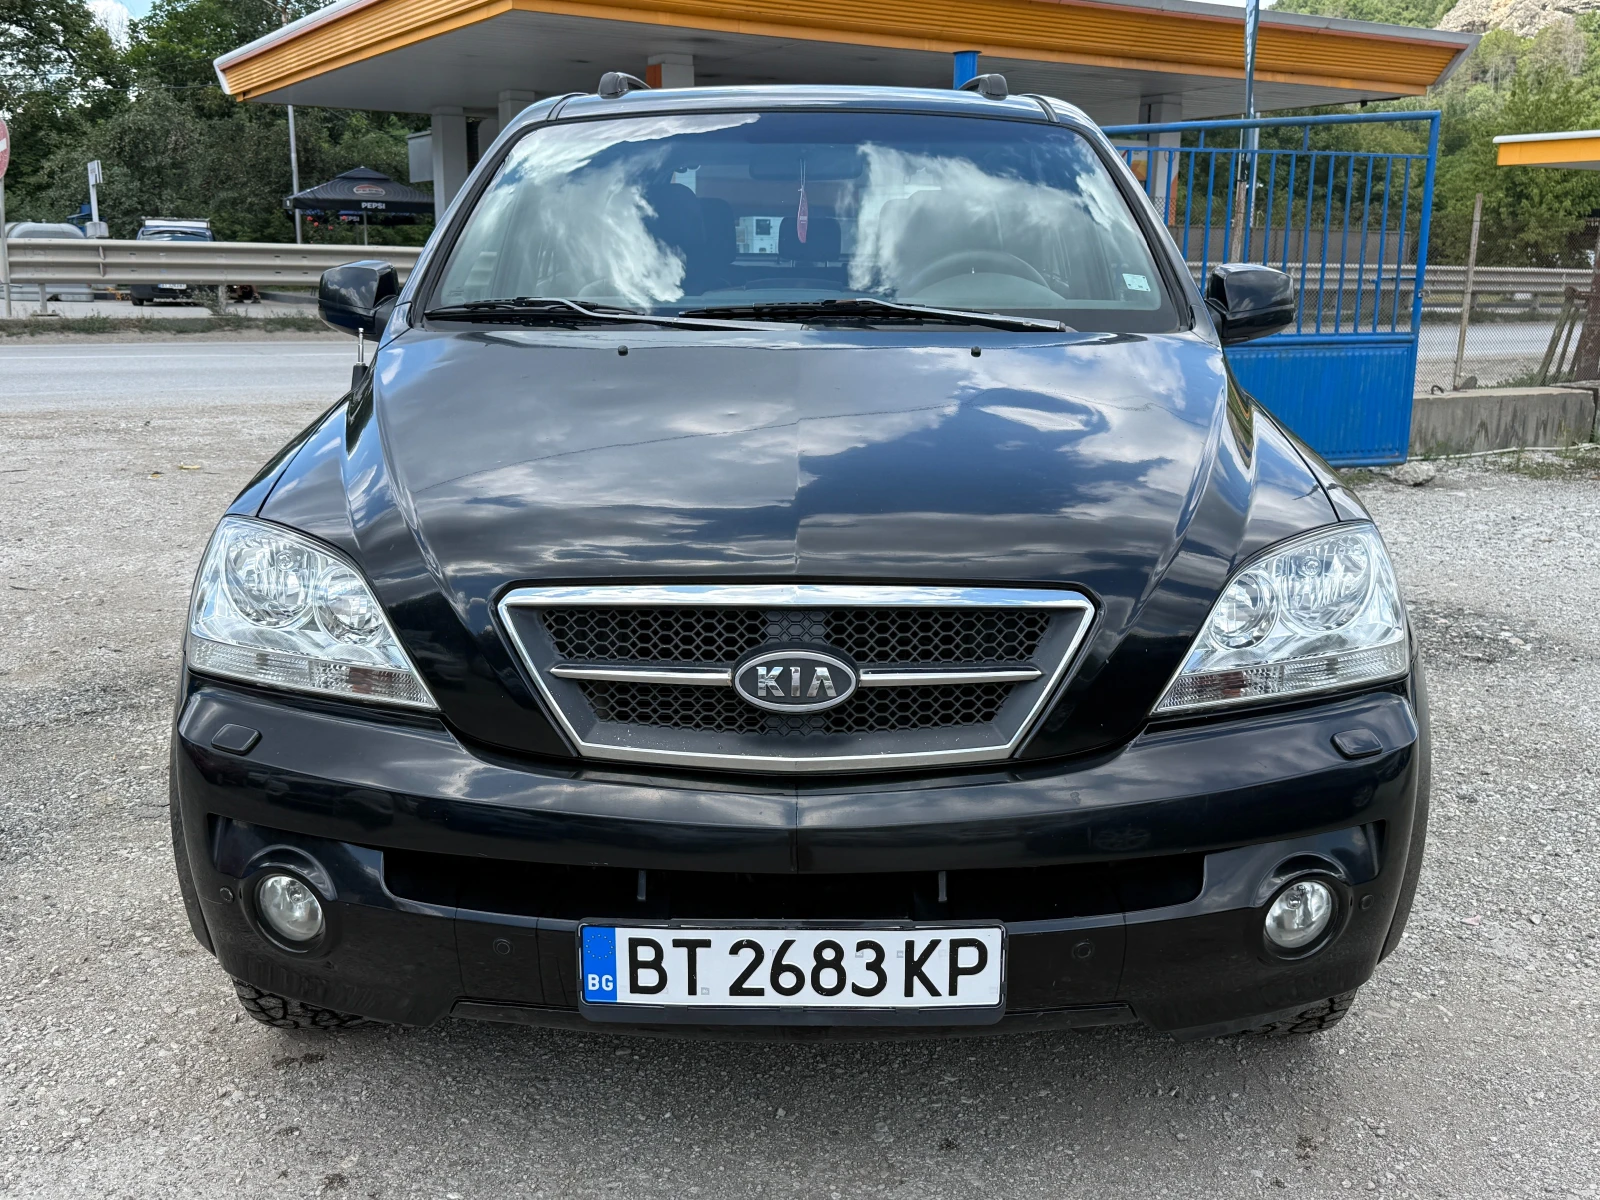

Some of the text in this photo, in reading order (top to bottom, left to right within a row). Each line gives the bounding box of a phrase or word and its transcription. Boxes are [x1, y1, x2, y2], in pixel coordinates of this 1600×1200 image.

[361, 202, 386, 210] PEPSI
[756, 666, 837, 697] KIA
[628, 937, 988, 997] BT 2683 KP
[588, 973, 614, 991] BG
